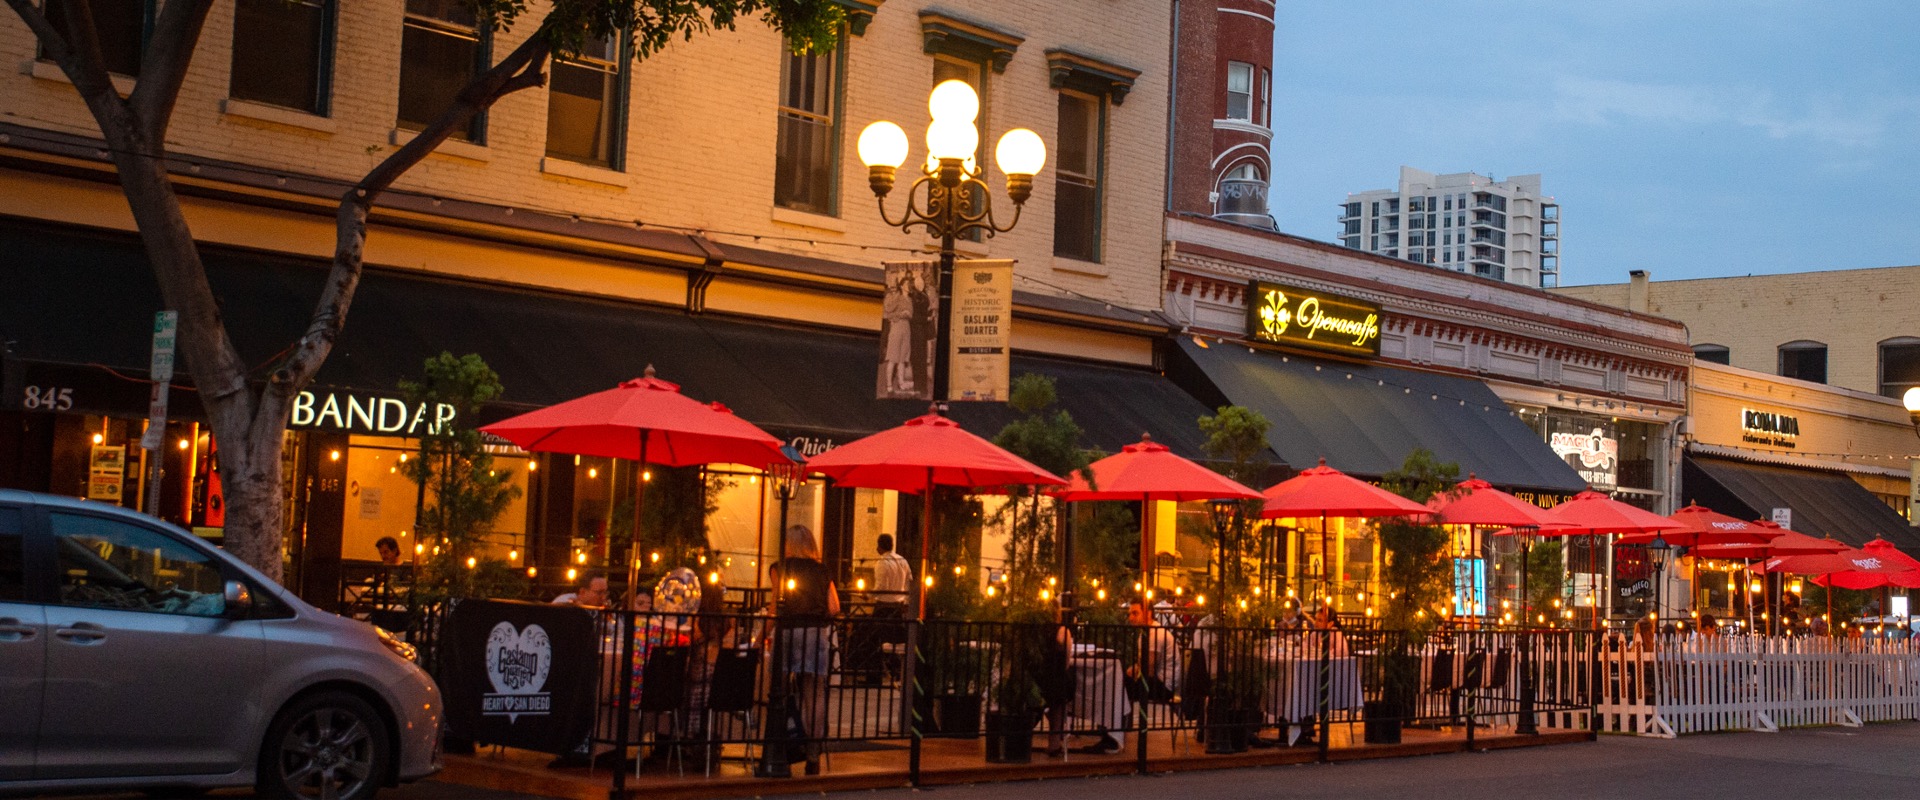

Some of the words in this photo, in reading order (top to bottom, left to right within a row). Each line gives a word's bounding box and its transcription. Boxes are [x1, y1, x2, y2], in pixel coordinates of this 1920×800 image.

[963, 315, 1000, 324] GASLAMP
[1297, 297, 1378, 346] Operacaffe
[964, 325, 998, 335] QUARTER
[24, 385, 74, 411] 845
[292, 391, 456, 436] BANDAR
[481, 431, 513, 443] Persi
[1553, 435, 1591, 448] MAGIC
[1743, 433, 1772, 446] ristorante
[1774, 437, 1796, 449] italiano
[791, 436, 841, 455] Chick
[1538, 494, 1559, 508] WINE
[498, 644, 538, 674] Gaslamp
[484, 696, 505, 711] HEART
[515, 697, 528, 711] SAN
[528, 696, 550, 711] DIEGO
